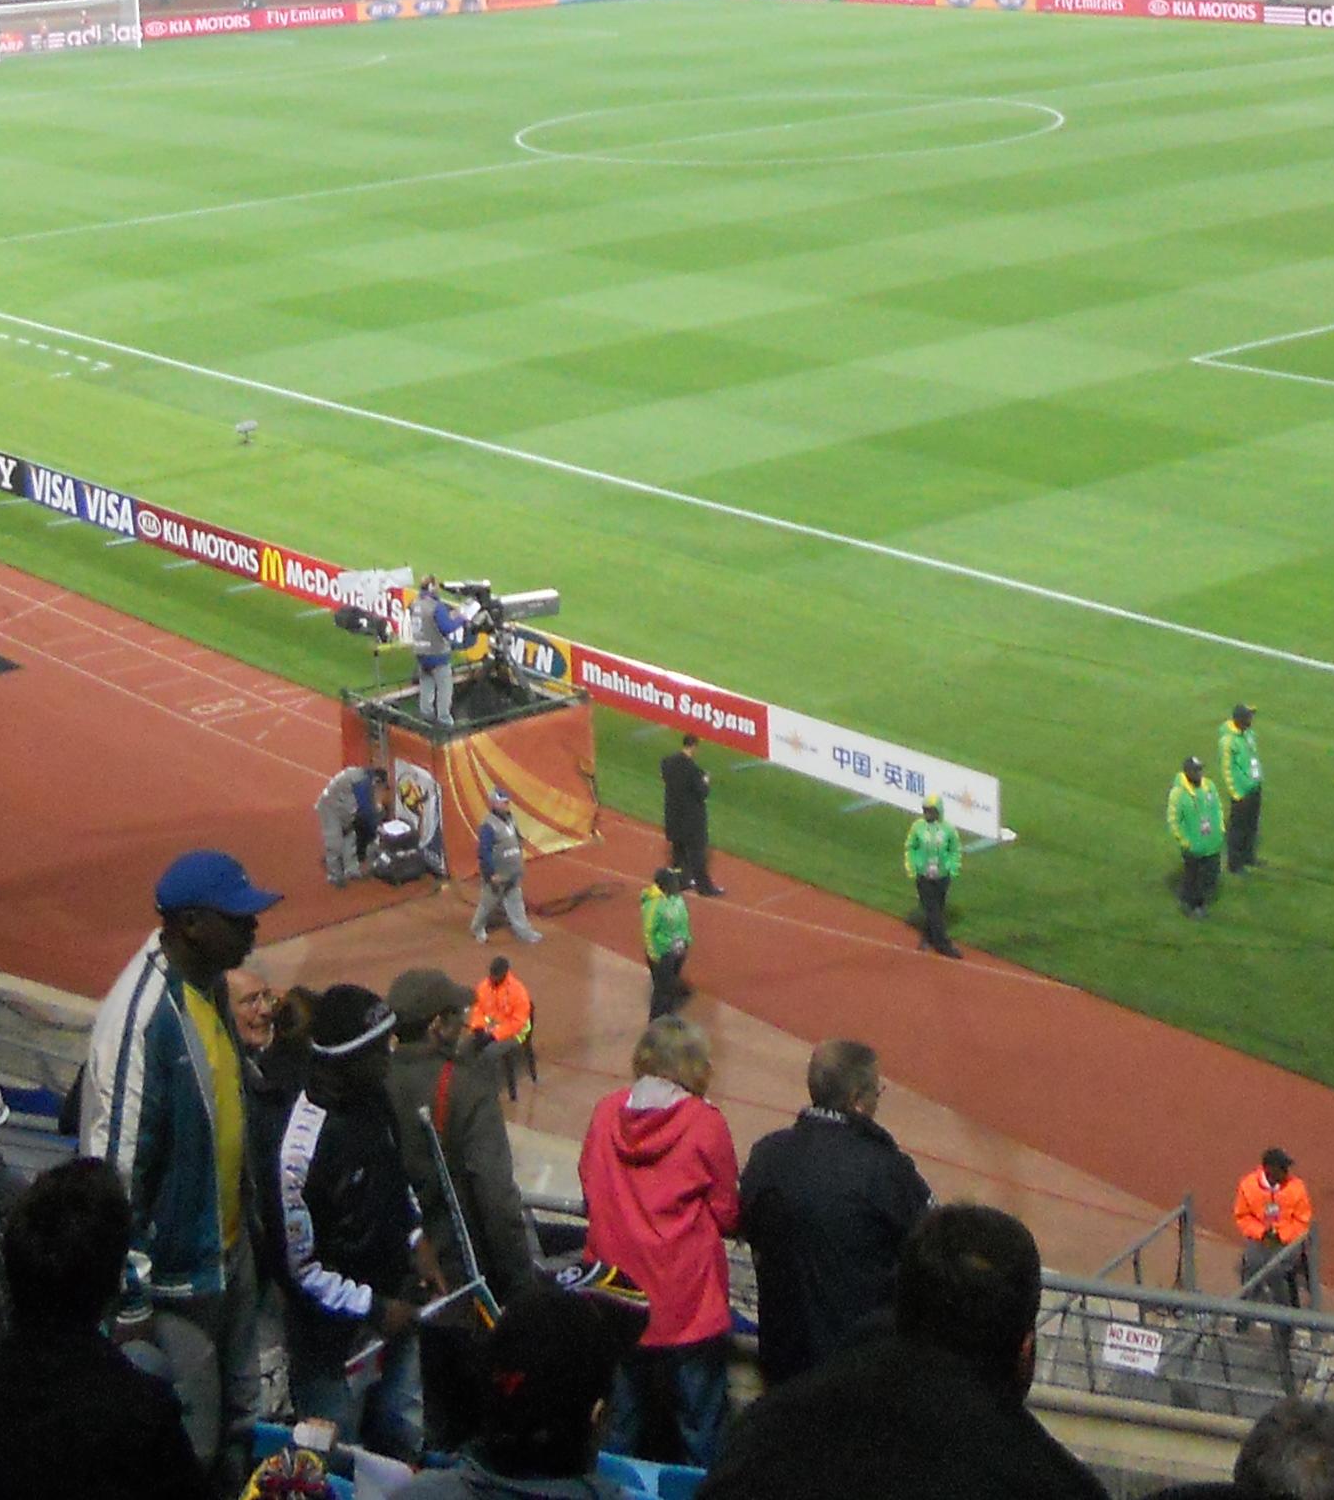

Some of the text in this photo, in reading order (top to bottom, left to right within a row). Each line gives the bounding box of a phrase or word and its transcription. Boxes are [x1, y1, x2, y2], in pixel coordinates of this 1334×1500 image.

[67, 22, 144, 46] adias
[169, 18, 192, 34] KIA
[195, 13, 251, 32] MOTORS
[267, 5, 344, 27] Fly Emirates
[1172, 1, 1195, 17] KIA
[1199, 2, 1257, 20] MOTORS
[30, 465, 78, 516] VISA
[83, 484, 135, 536] VISA
[163, 519, 189, 549] KIA
[192, 529, 259, 574] MOTORS
[286, 558, 404, 622] McDonad's
[582, 660, 757, 736] Mahindra Satyam
[832, 746, 925, 797] 中国·英利
[1109, 1325, 1159, 1348] NO ENTRY
